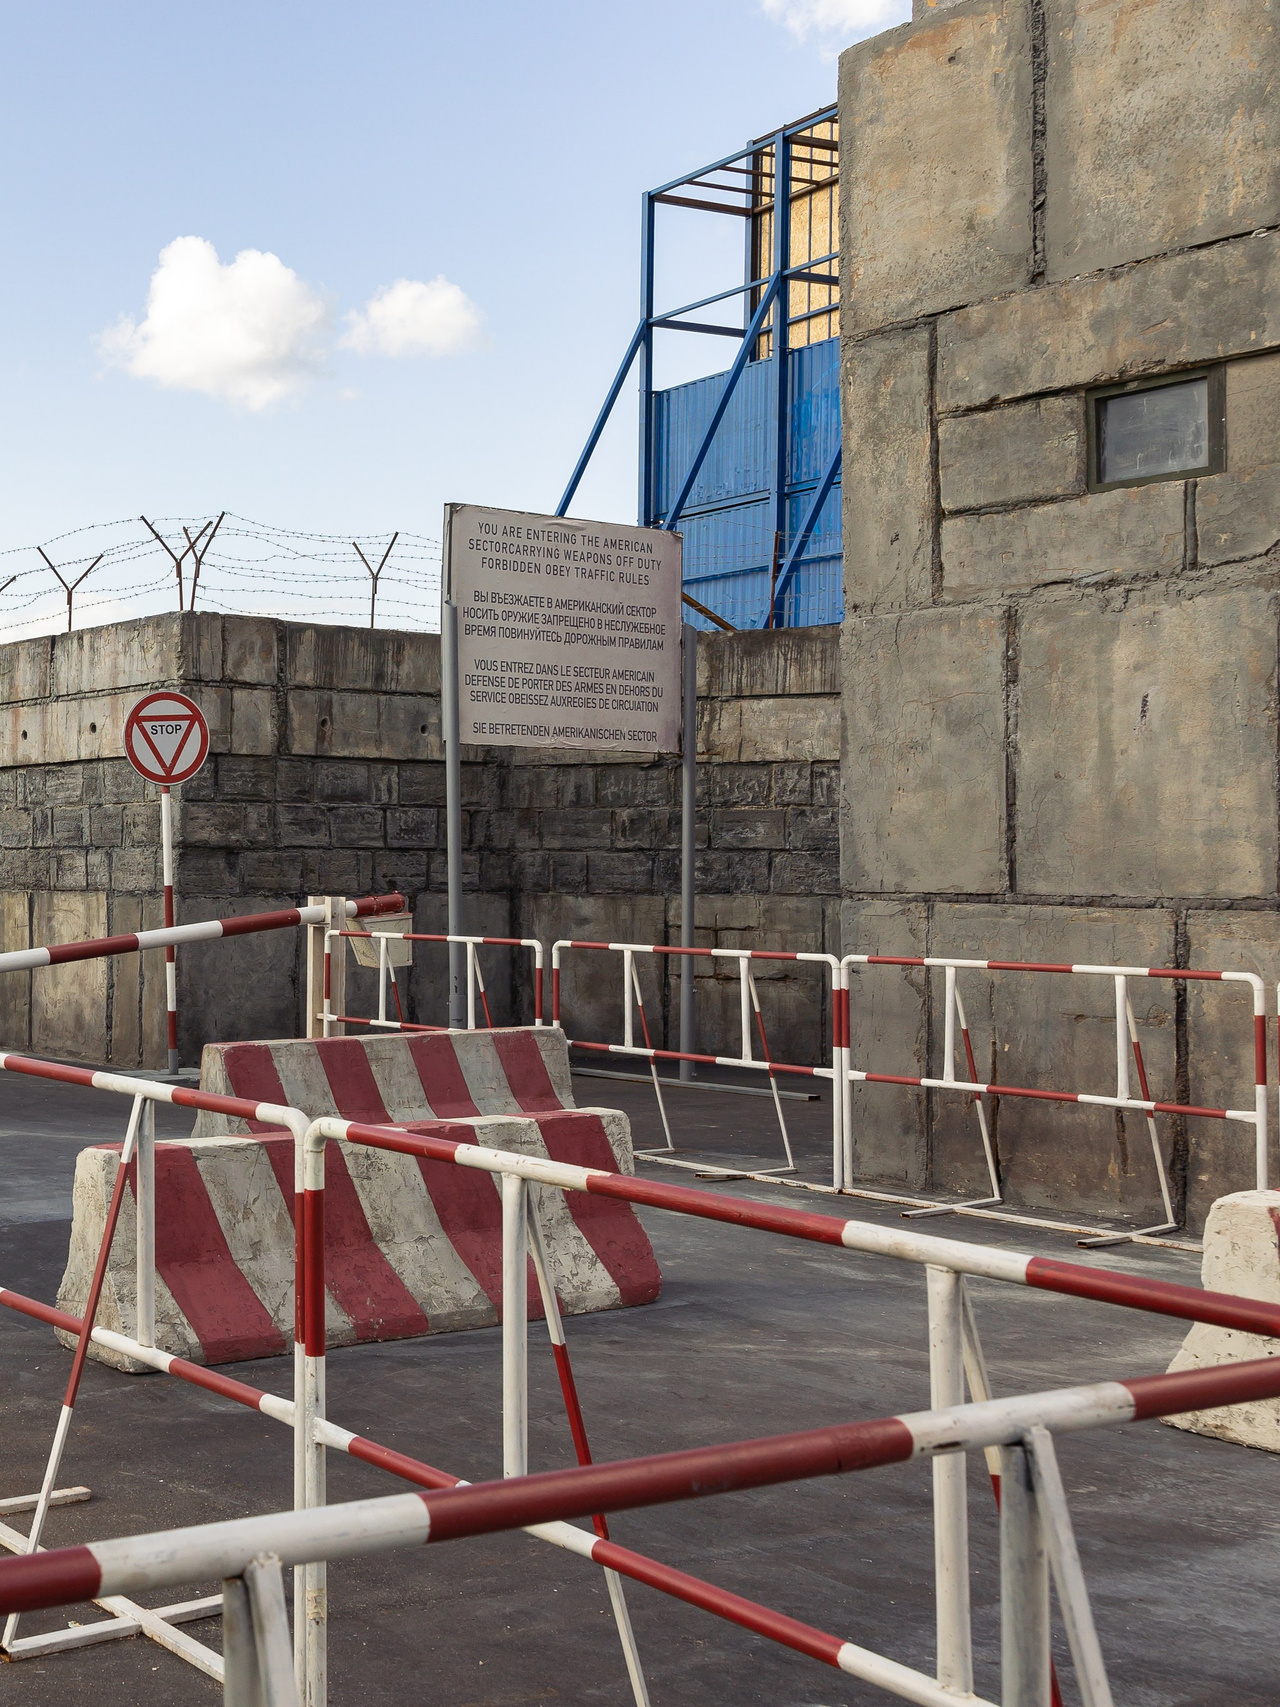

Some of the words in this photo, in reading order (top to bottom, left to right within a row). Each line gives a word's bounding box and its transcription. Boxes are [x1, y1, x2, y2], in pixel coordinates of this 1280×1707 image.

[478, 522, 498, 535] YOU
[502, 525, 522, 539] ARE
[526, 528, 577, 545] ENTERING
[581, 534, 600, 548] THE
[603, 538, 653, 554] AMERICAN
[481, 556, 541, 574] FORBIDDEN
[545, 564, 571, 577] OBEY
[574, 566, 615, 582] TRAFFIC
[619, 571, 650, 586] RULES
[563, 549, 612, 565] WEAPONS
[616, 555, 634, 567] OFF
[637, 557, 662, 571] DUTY
[473, 590, 489, 603] ВЫ
[490, 591, 545, 608] ВЪЕЗЖАЕТЕ
[546, 597, 553, 609] В
[554, 598, 624, 616] АМЕРИКАНСКИЙ
[625, 605, 657, 618] СЕКТОР
[462, 606, 499, 621] НОСИТЬ
[501, 610, 540, 624] ОРУЖИЕ
[541, 613, 596, 630] ЗАПРЕЩЕНО
[597, 618, 603, 630] В
[604, 619, 666, 635] НЕСЛУЖЕБНОЕ
[464, 623, 497, 637] ВРЕМЯ
[498, 626, 562, 643] ПОВИНУЙТЕСЬ
[563, 632, 616, 647] ДОРОЖНЫМ
[618, 636, 664, 651] ПРАВИЛАМ
[473, 658, 499, 672] VOUS
[500, 661, 534, 674] ENTREZ
[535, 663, 559, 676] DANS
[560, 665, 571, 677] LE
[573, 666, 610, 680] SECTEUR
[611, 669, 655, 683] AMERICAIN
[464, 674, 506, 688] DEFENSE
[507, 677, 520, 689] DE
[521, 678, 554, 691] PORTER
[555, 680, 573, 692] DES
[574, 681, 604, 694] ARMES
[605, 683, 617, 695] EN
[618, 684, 651, 698] DEHORS
[651, 686, 664, 698] DU
[470, 690, 507, 704] SERVICE
[508, 692, 549, 706] OBEISSEZ
[598, 698, 610, 710] DE
[150, 724, 182, 735] STOP
[472, 722, 487, 734] SIE
[551, 725, 626, 741] AMERIKANISCHEN
[627, 729, 658, 742] SECTOR
